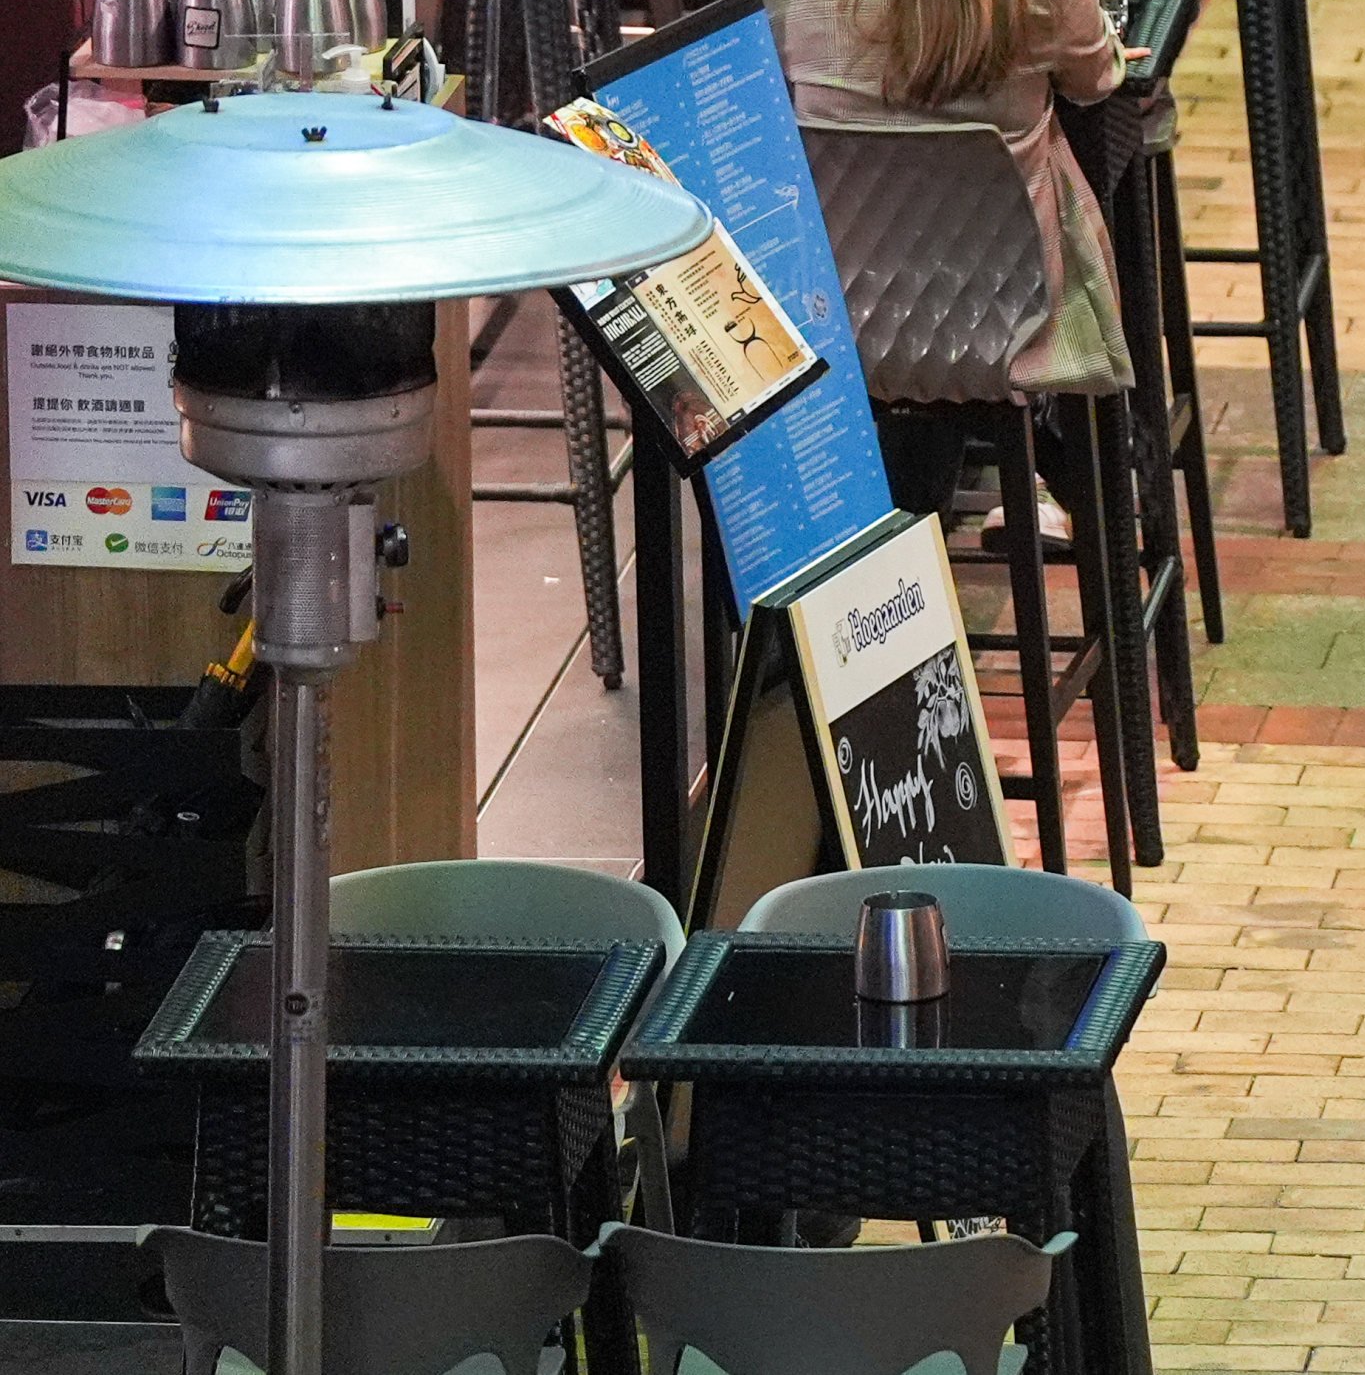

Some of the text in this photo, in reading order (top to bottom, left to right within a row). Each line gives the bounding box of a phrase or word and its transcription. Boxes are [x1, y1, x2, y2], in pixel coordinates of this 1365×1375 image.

[23, 490, 67, 507] VISA
[87, 496, 132, 507] MasterCard
[209, 497, 250, 510] UnionPay
[50, 534, 83, 546] 支付宝
[847, 577, 925, 653] Hoegaarden
[853, 754, 934, 847] Happy
